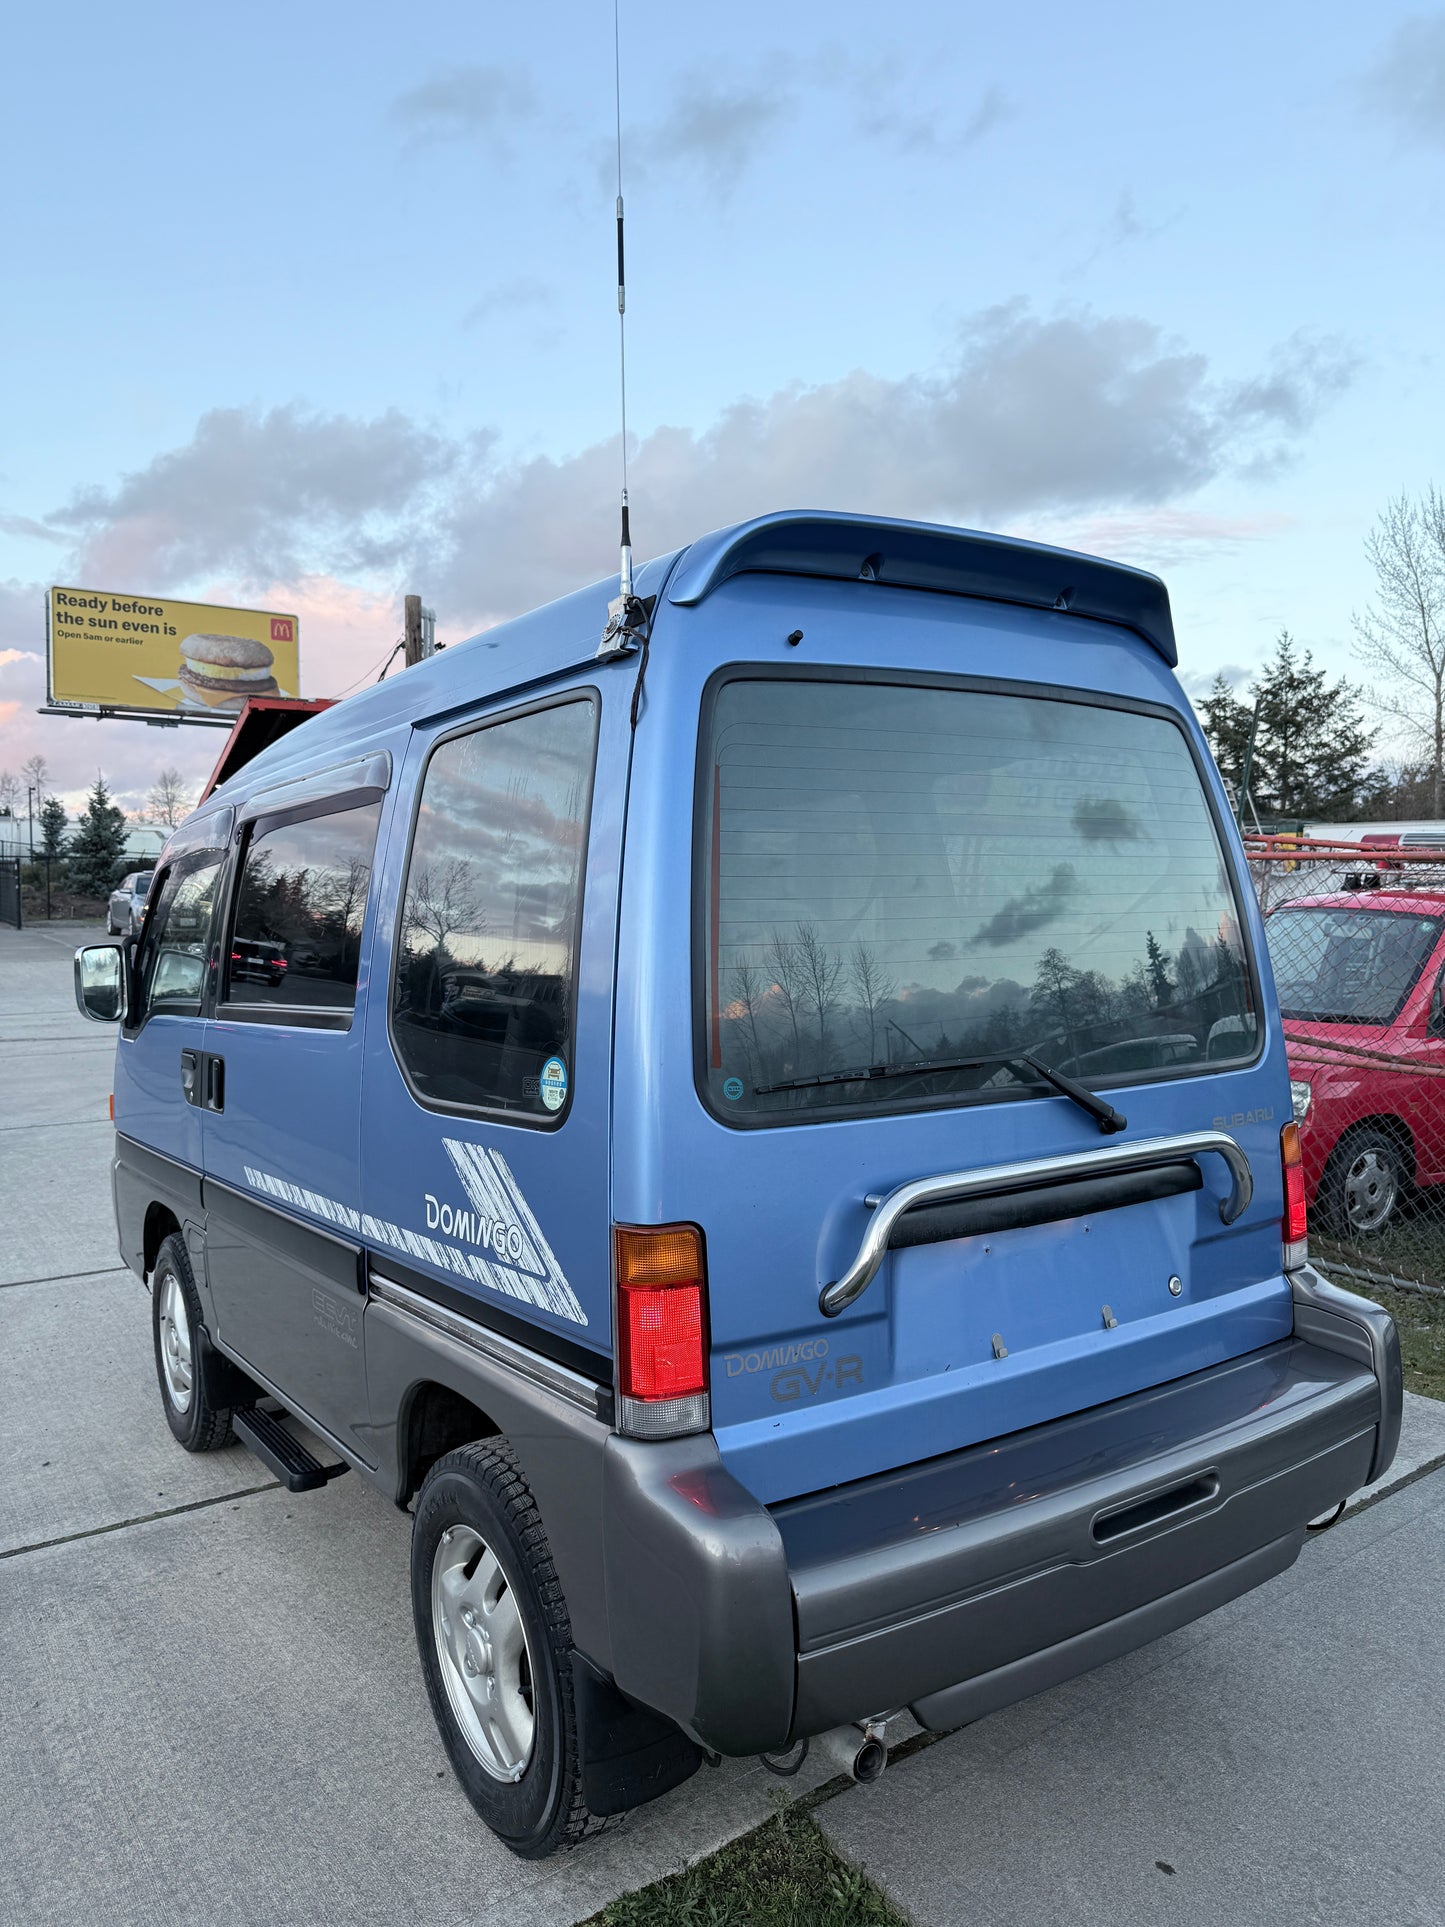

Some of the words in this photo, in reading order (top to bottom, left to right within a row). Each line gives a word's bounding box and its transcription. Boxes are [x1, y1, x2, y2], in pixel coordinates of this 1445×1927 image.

[56, 592, 107, 613] Ready
[112, 599, 164, 616] before
[56, 611, 84, 625] the
[88, 617, 118, 630] sun
[122, 620, 159, 634] even
[163, 622, 177, 636] is
[57, 630, 81, 639] Open
[83, 632, 103, 641] 5am
[115, 636, 144, 646] earlier
[1212, 1106, 1275, 1131] SUBARU
[424, 1193, 523, 1261] DOMINGO
[724, 1338, 829, 1378] DOMINGO
